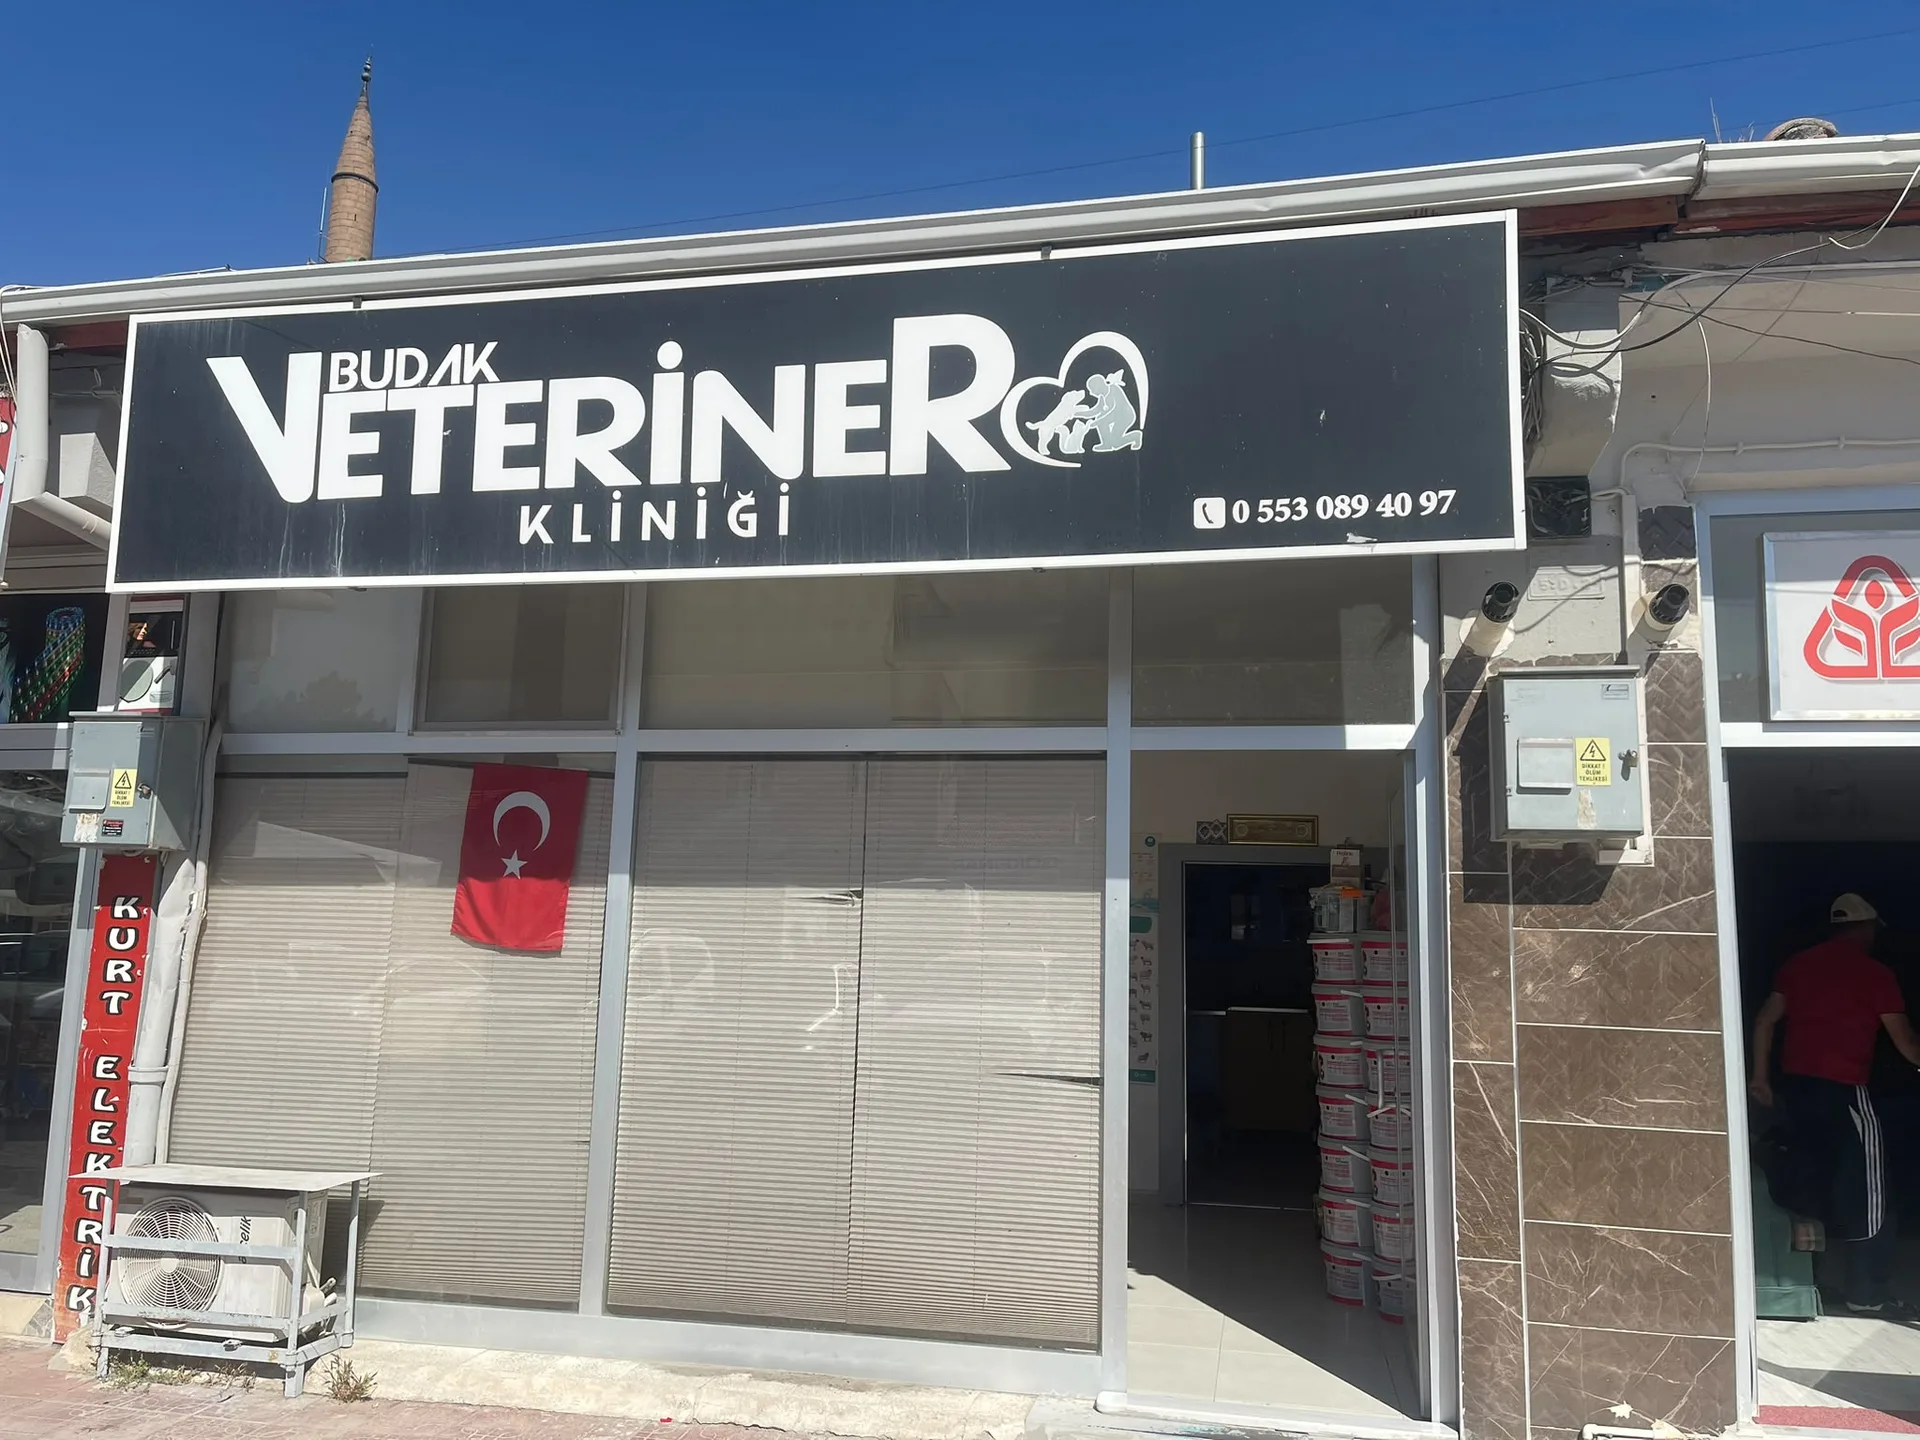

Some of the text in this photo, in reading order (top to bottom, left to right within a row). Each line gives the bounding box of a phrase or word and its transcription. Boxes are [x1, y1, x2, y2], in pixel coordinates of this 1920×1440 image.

[329, 341, 501, 392] BUDAK
[206, 313, 1016, 504] VETERİNER
[518, 482, 790, 546] KLİNİĞİ
[1232, 489, 1457, 524] 0 553 089 40 97
[101, 896, 140, 1015] KURT
